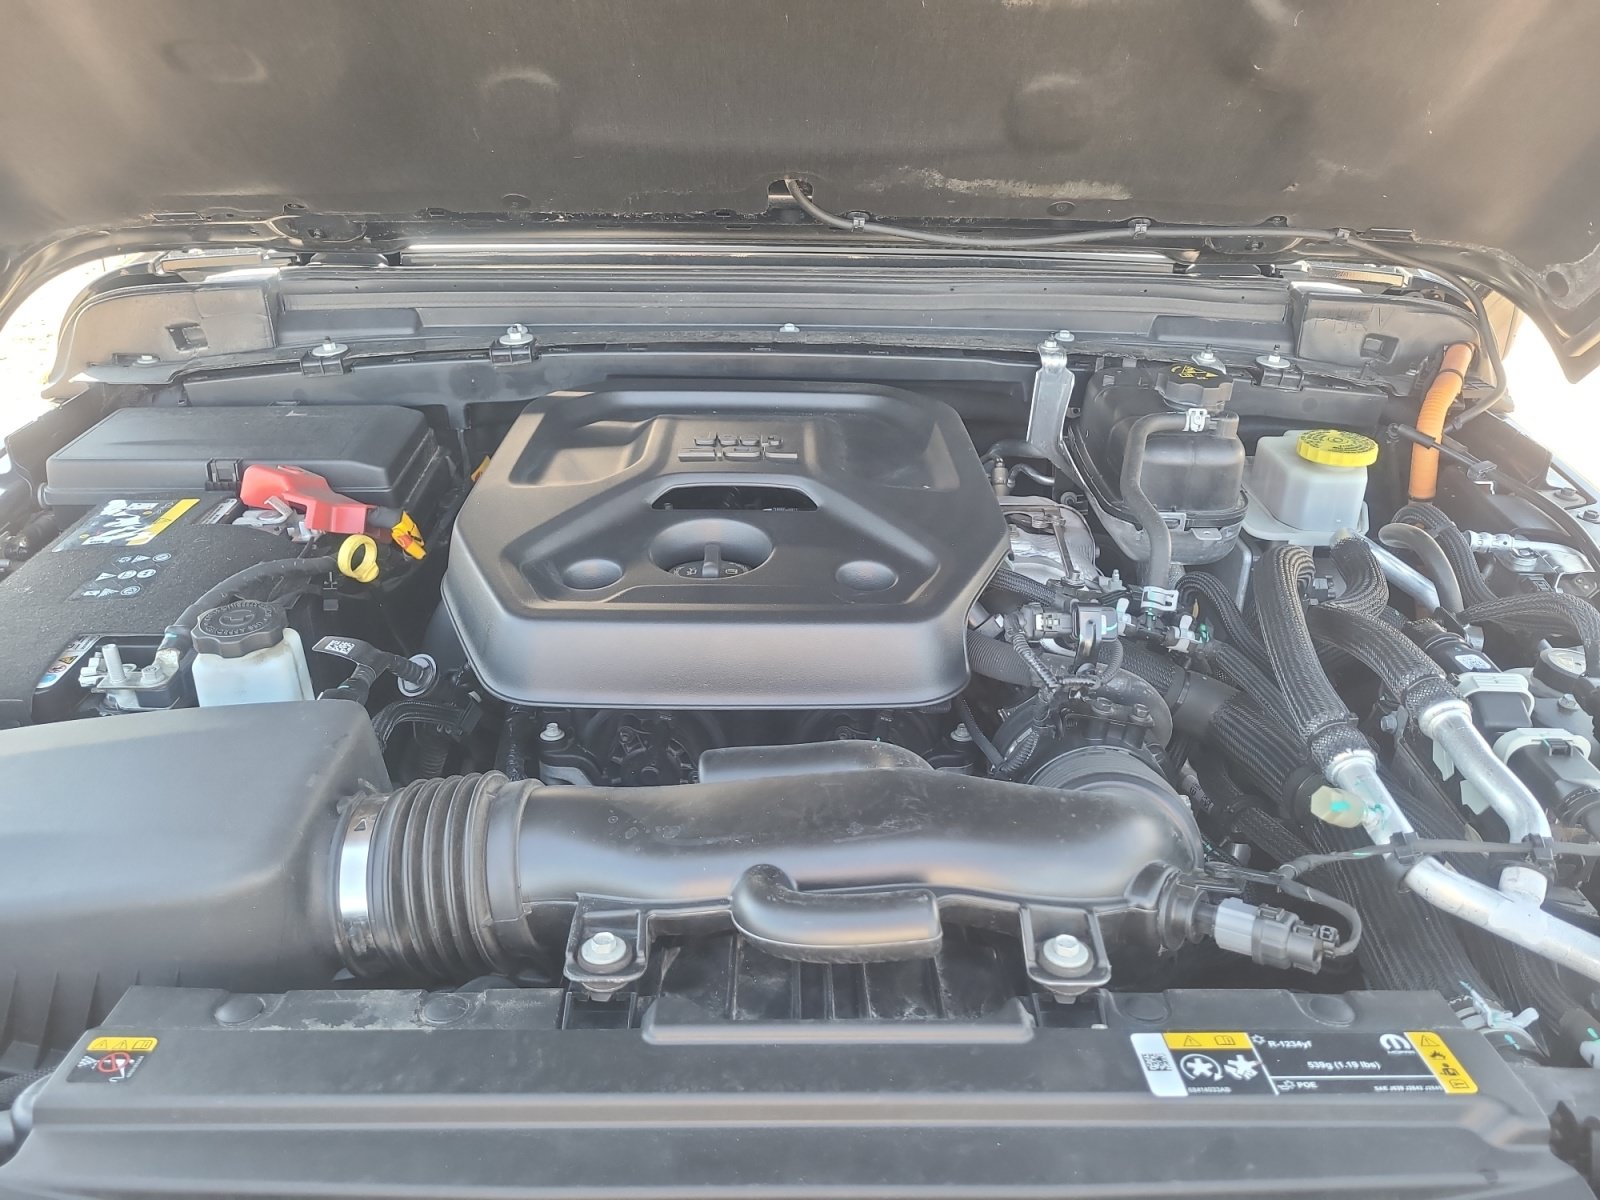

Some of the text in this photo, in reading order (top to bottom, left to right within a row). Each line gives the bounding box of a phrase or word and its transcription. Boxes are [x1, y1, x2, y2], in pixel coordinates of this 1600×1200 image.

[1267, 1040, 1312, 1050] R-1234yf
[1360, 1060, 1381, 1071] lbs)
[1296, 1081, 1318, 1089] POE
